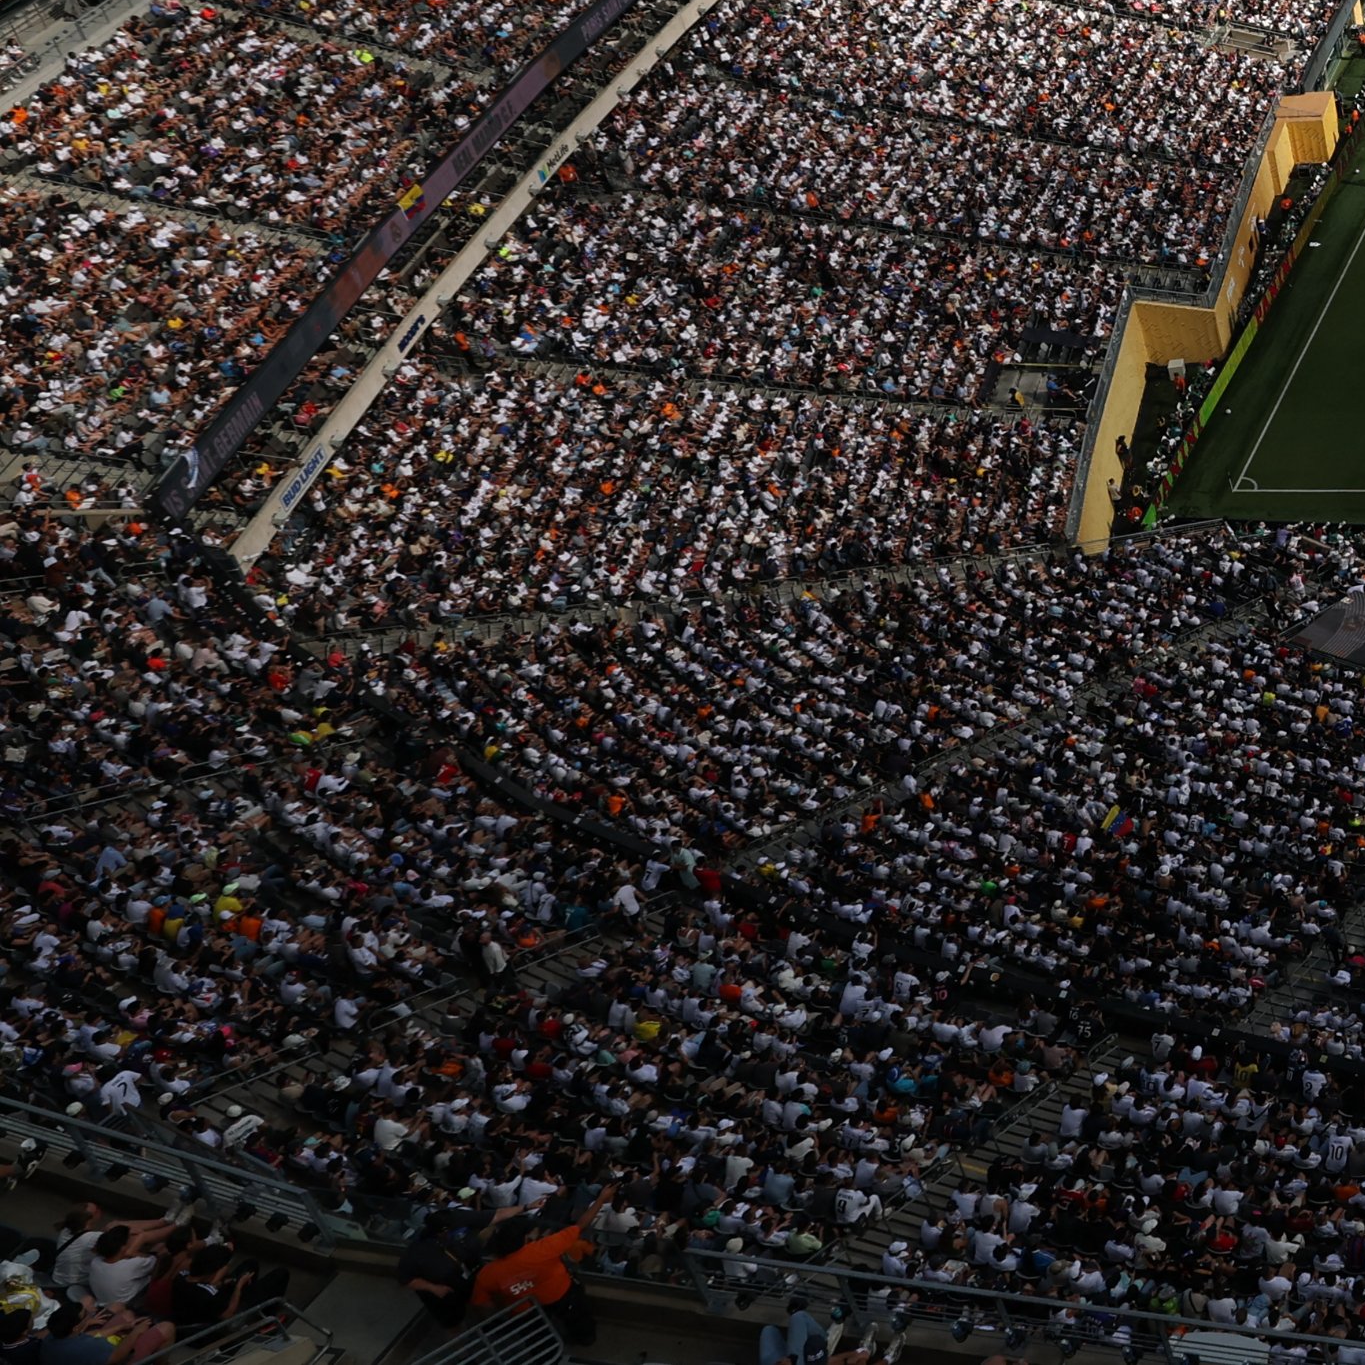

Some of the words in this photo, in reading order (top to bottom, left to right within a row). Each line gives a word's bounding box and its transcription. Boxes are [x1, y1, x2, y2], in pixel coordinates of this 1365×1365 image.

[546, 144, 570, 171] MetLife
[282, 485, 301, 508] BUD
[300, 448, 325, 486] LIGHT
